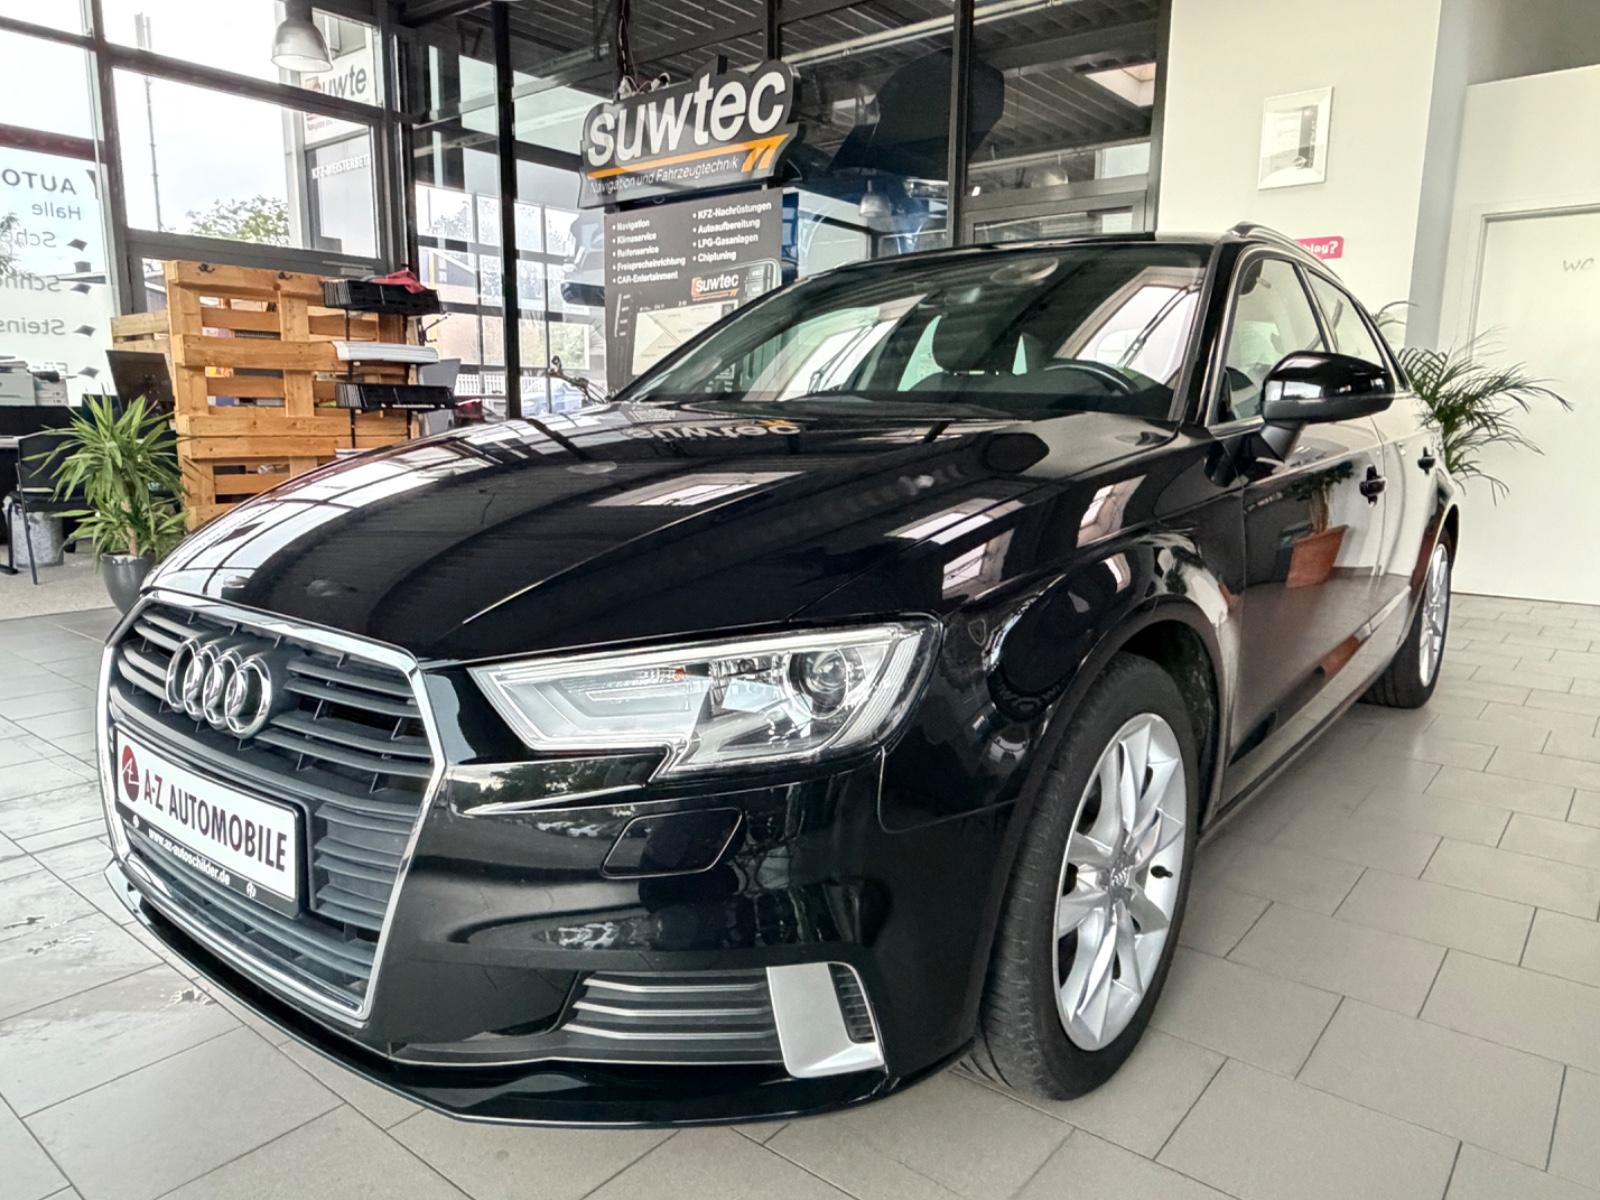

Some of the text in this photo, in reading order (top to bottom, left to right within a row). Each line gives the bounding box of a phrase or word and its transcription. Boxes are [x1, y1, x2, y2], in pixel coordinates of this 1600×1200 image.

[587, 71, 786, 167] suwtec
[590, 156, 739, 194] Navigation und Fahrzeugtechnik
[698, 202, 772, 220] KFZ-Nachrüstungen
[617, 218, 651, 231] Navigation
[698, 219, 760, 234] Autoaufbereitung
[617, 232, 657, 244] Klimaservice
[698, 234, 759, 249] LPG-Gasanlagen
[698, 250, 737, 263] Chiptuning
[617, 270, 679, 284] CAR-Entertainment
[695, 273, 740, 293] suwtec
[144, 768, 288, 872] A-Z AUTOMOBILE
